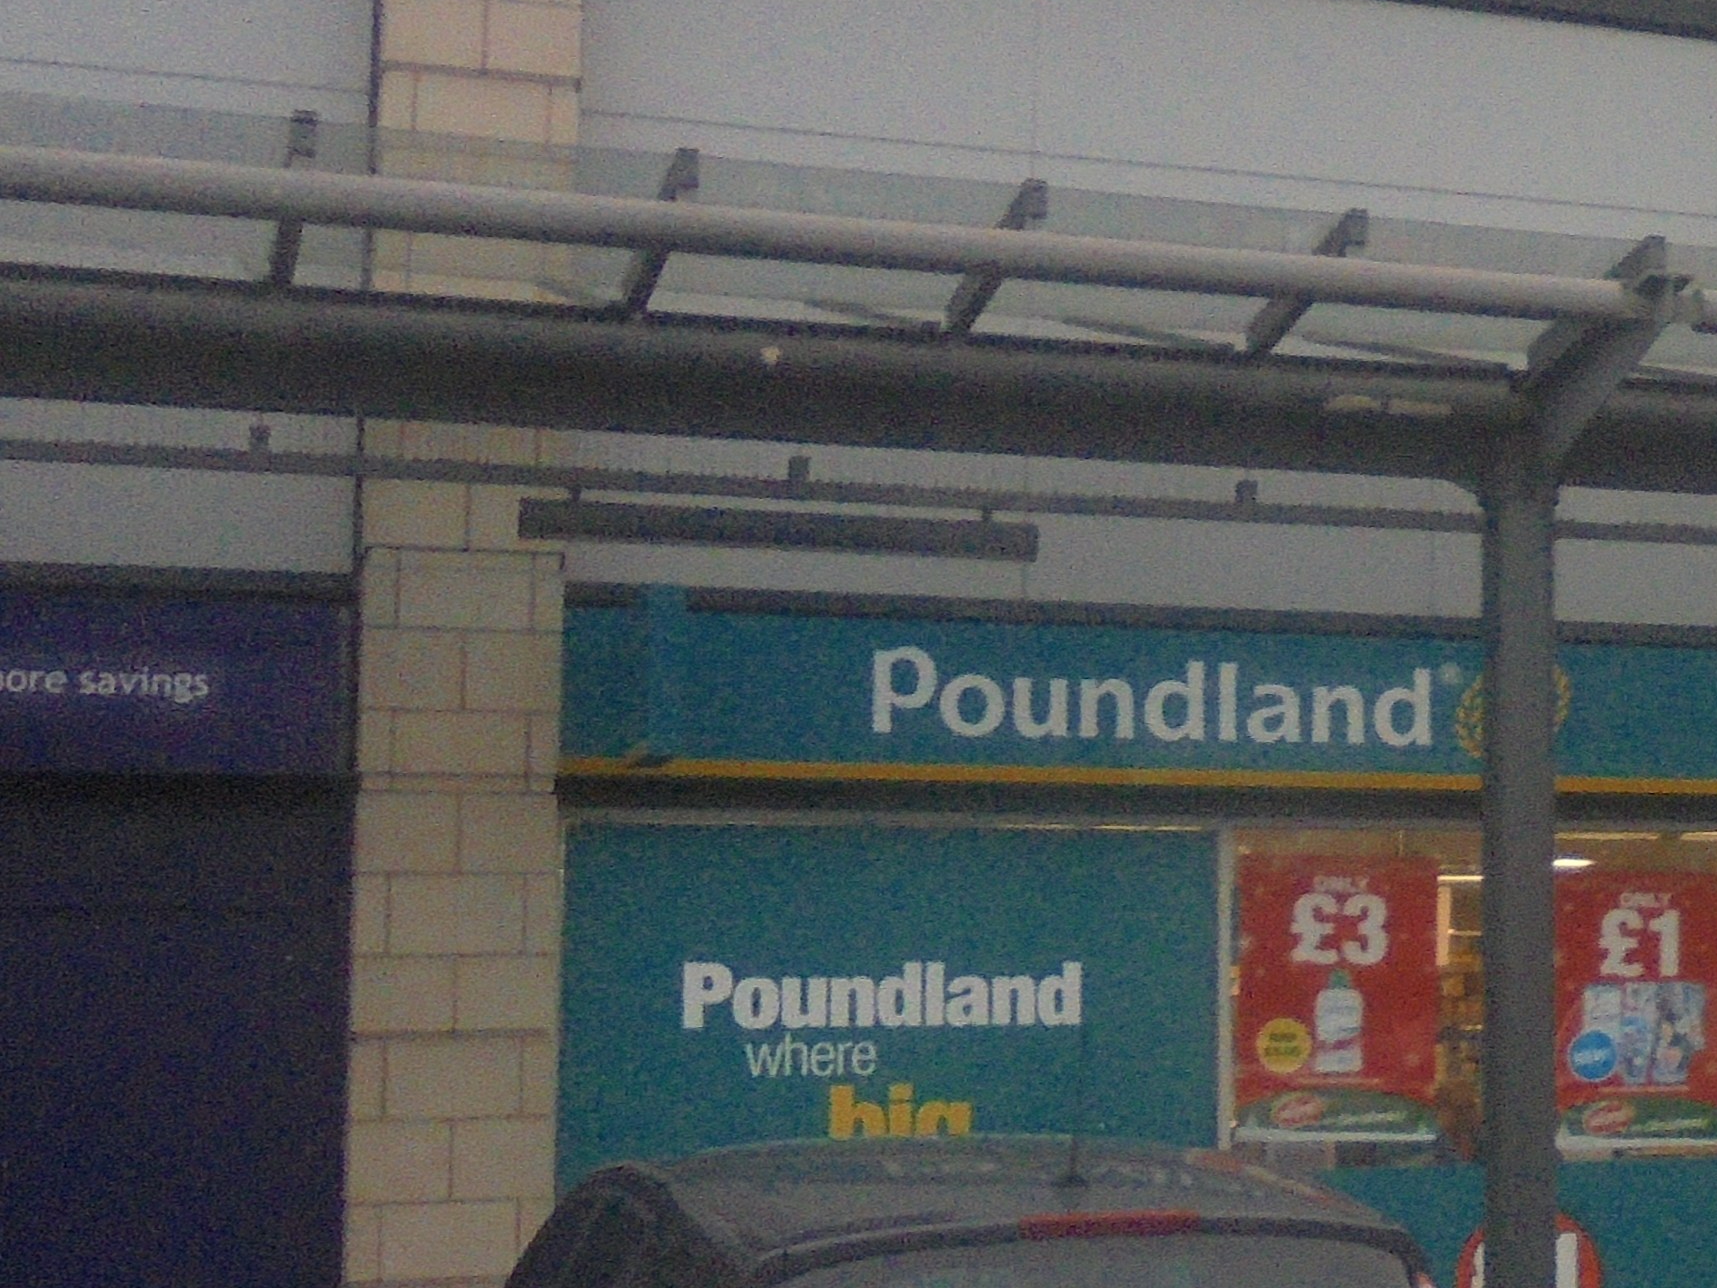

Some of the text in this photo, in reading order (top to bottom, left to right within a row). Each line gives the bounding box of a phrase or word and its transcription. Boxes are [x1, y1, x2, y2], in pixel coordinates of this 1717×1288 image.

[79, 665, 210, 704] savings
[871, 645, 1433, 746] Poundland
[1290, 892, 1388, 965] £3
[1599, 908, 1681, 978] £1
[682, 961, 1083, 1029] Poundland
[746, 1033, 878, 1078] where
